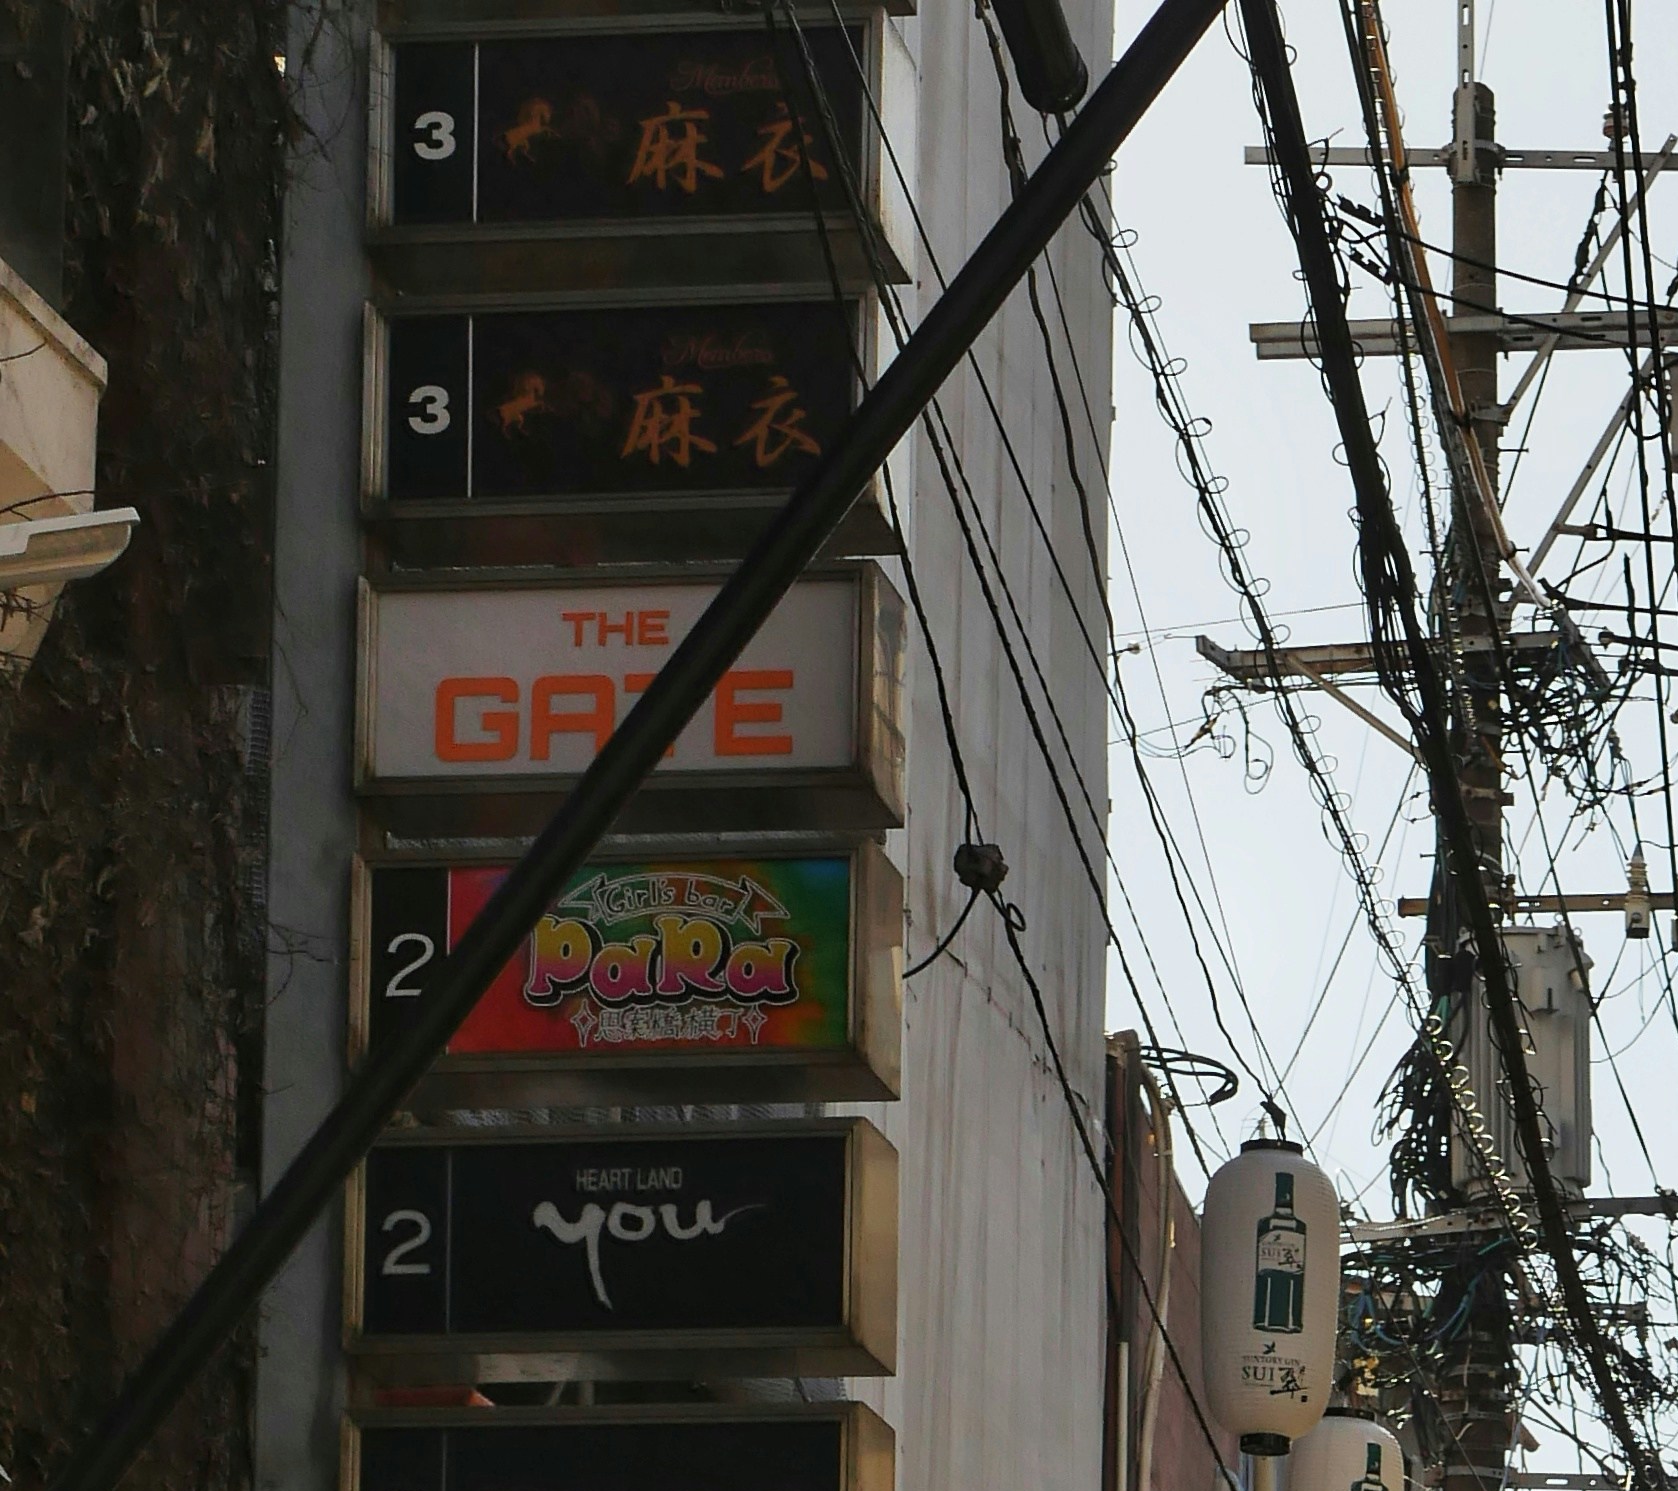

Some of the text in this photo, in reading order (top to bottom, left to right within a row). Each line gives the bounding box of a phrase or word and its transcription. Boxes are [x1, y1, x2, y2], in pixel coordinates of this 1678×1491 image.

[413, 111, 456, 160] 3
[626, 104, 828, 192] 麻衣
[407, 386, 451, 434] 3
[620, 375, 821, 467] 麻衣
[562, 610, 670, 647] THE
[684, 877, 735, 913] bar
[385, 933, 435, 998] 2
[576, 1167, 682, 1191] HEART LAND
[380, 1208, 432, 1276] 2
[533, 1199, 767, 1312] you
[1242, 1365, 1274, 1381] SUI
